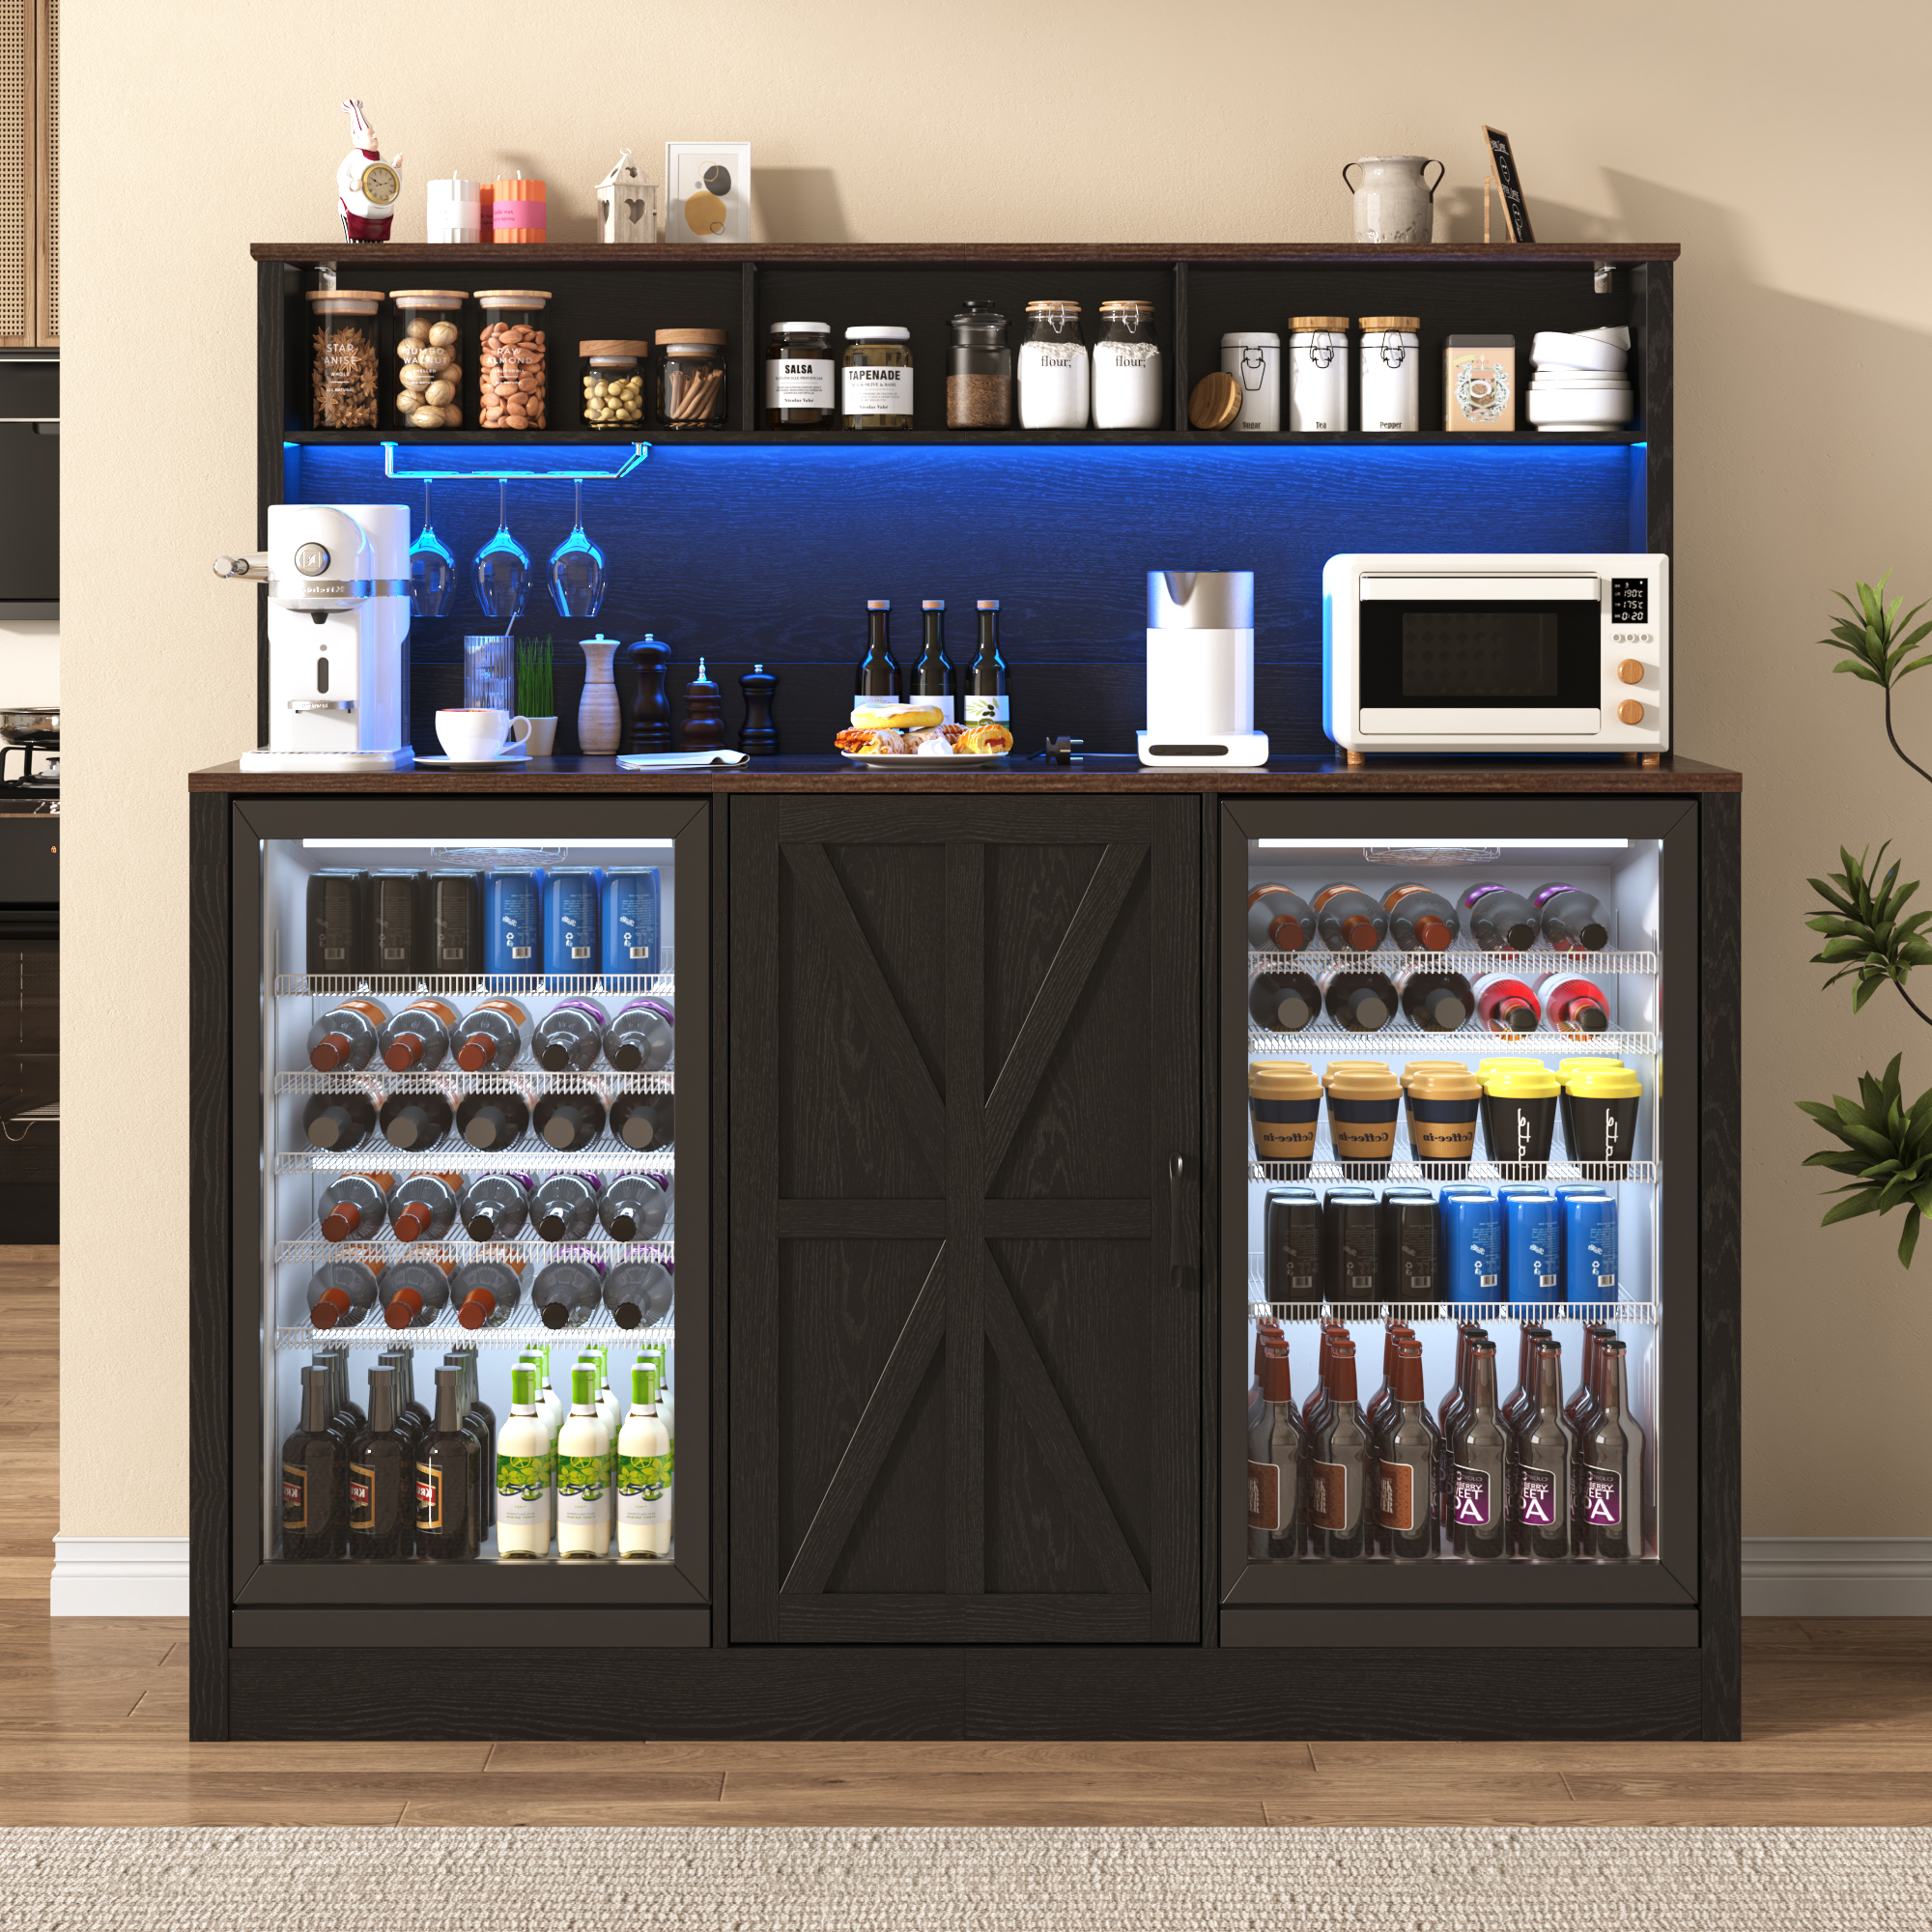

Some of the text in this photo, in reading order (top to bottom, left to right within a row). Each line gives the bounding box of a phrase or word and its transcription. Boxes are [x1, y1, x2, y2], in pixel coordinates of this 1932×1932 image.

[327, 344, 355, 353] STAR
[1041, 355, 1071, 368] flour;
[1116, 355, 1146, 368] flour;
[784, 364, 813, 374] SALSA
[849, 370, 901, 381] TAPENADE
[1621, 611, 1644, 621] 0:20
